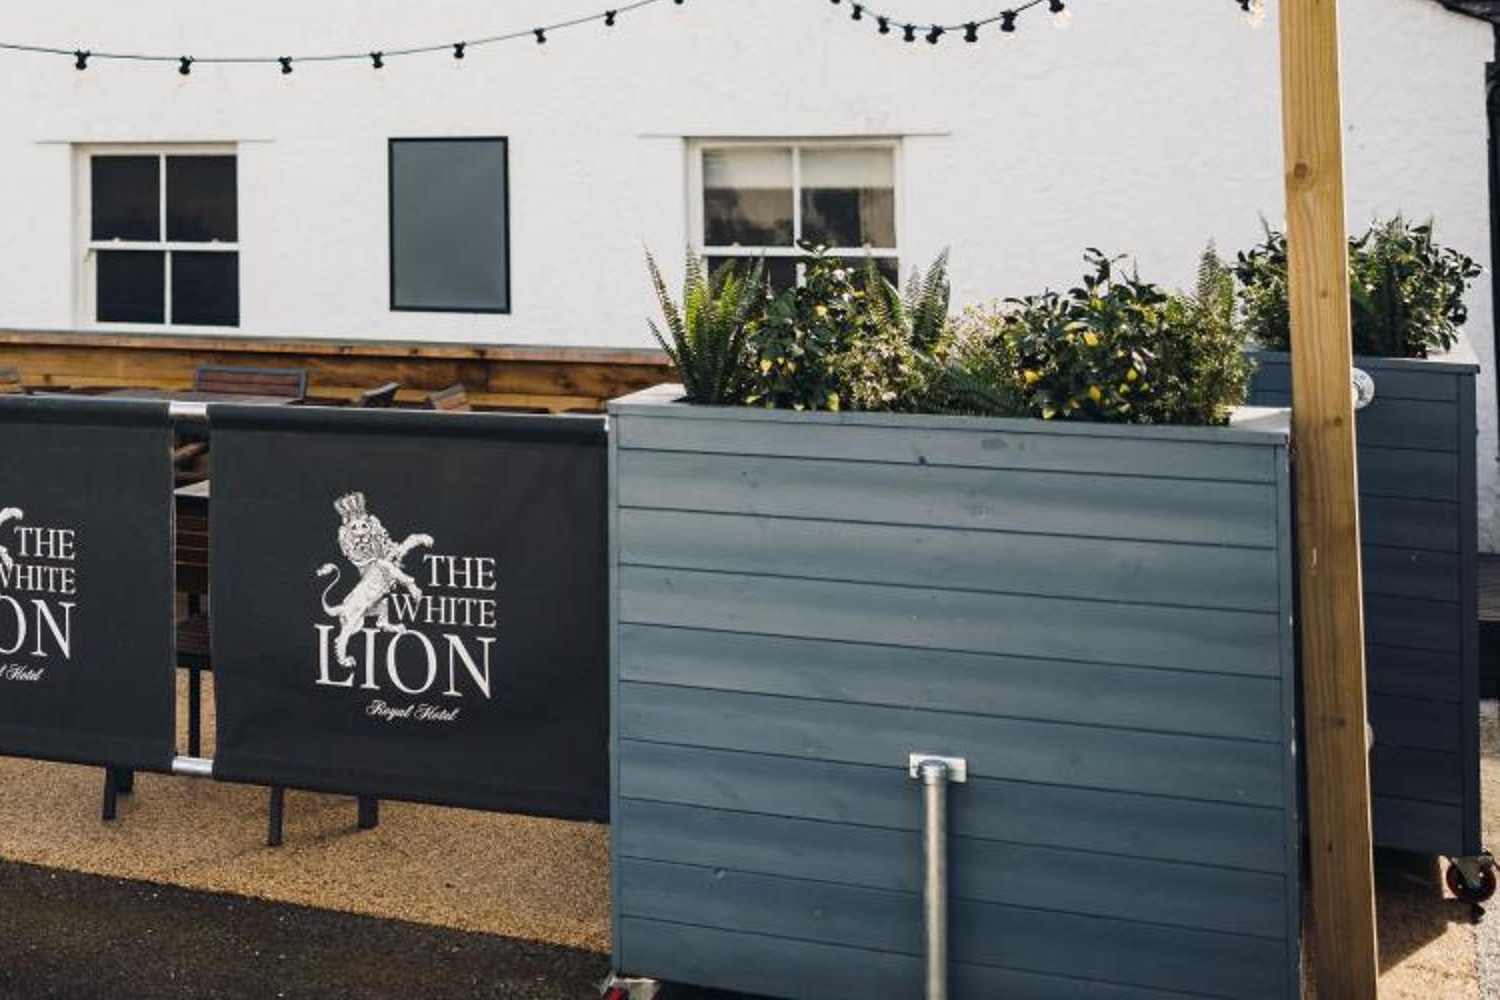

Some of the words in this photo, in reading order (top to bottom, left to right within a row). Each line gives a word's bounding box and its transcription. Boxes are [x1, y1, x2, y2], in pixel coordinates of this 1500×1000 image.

[13, 525, 76, 560] THE
[422, 554, 498, 591] THE
[391, 593, 498, 628] WHITE
[5, 664, 45, 681] Hotel
[314, 623, 498, 699] LION
[366, 699, 414, 720] Royal
[413, 703, 460, 721] Hotel
